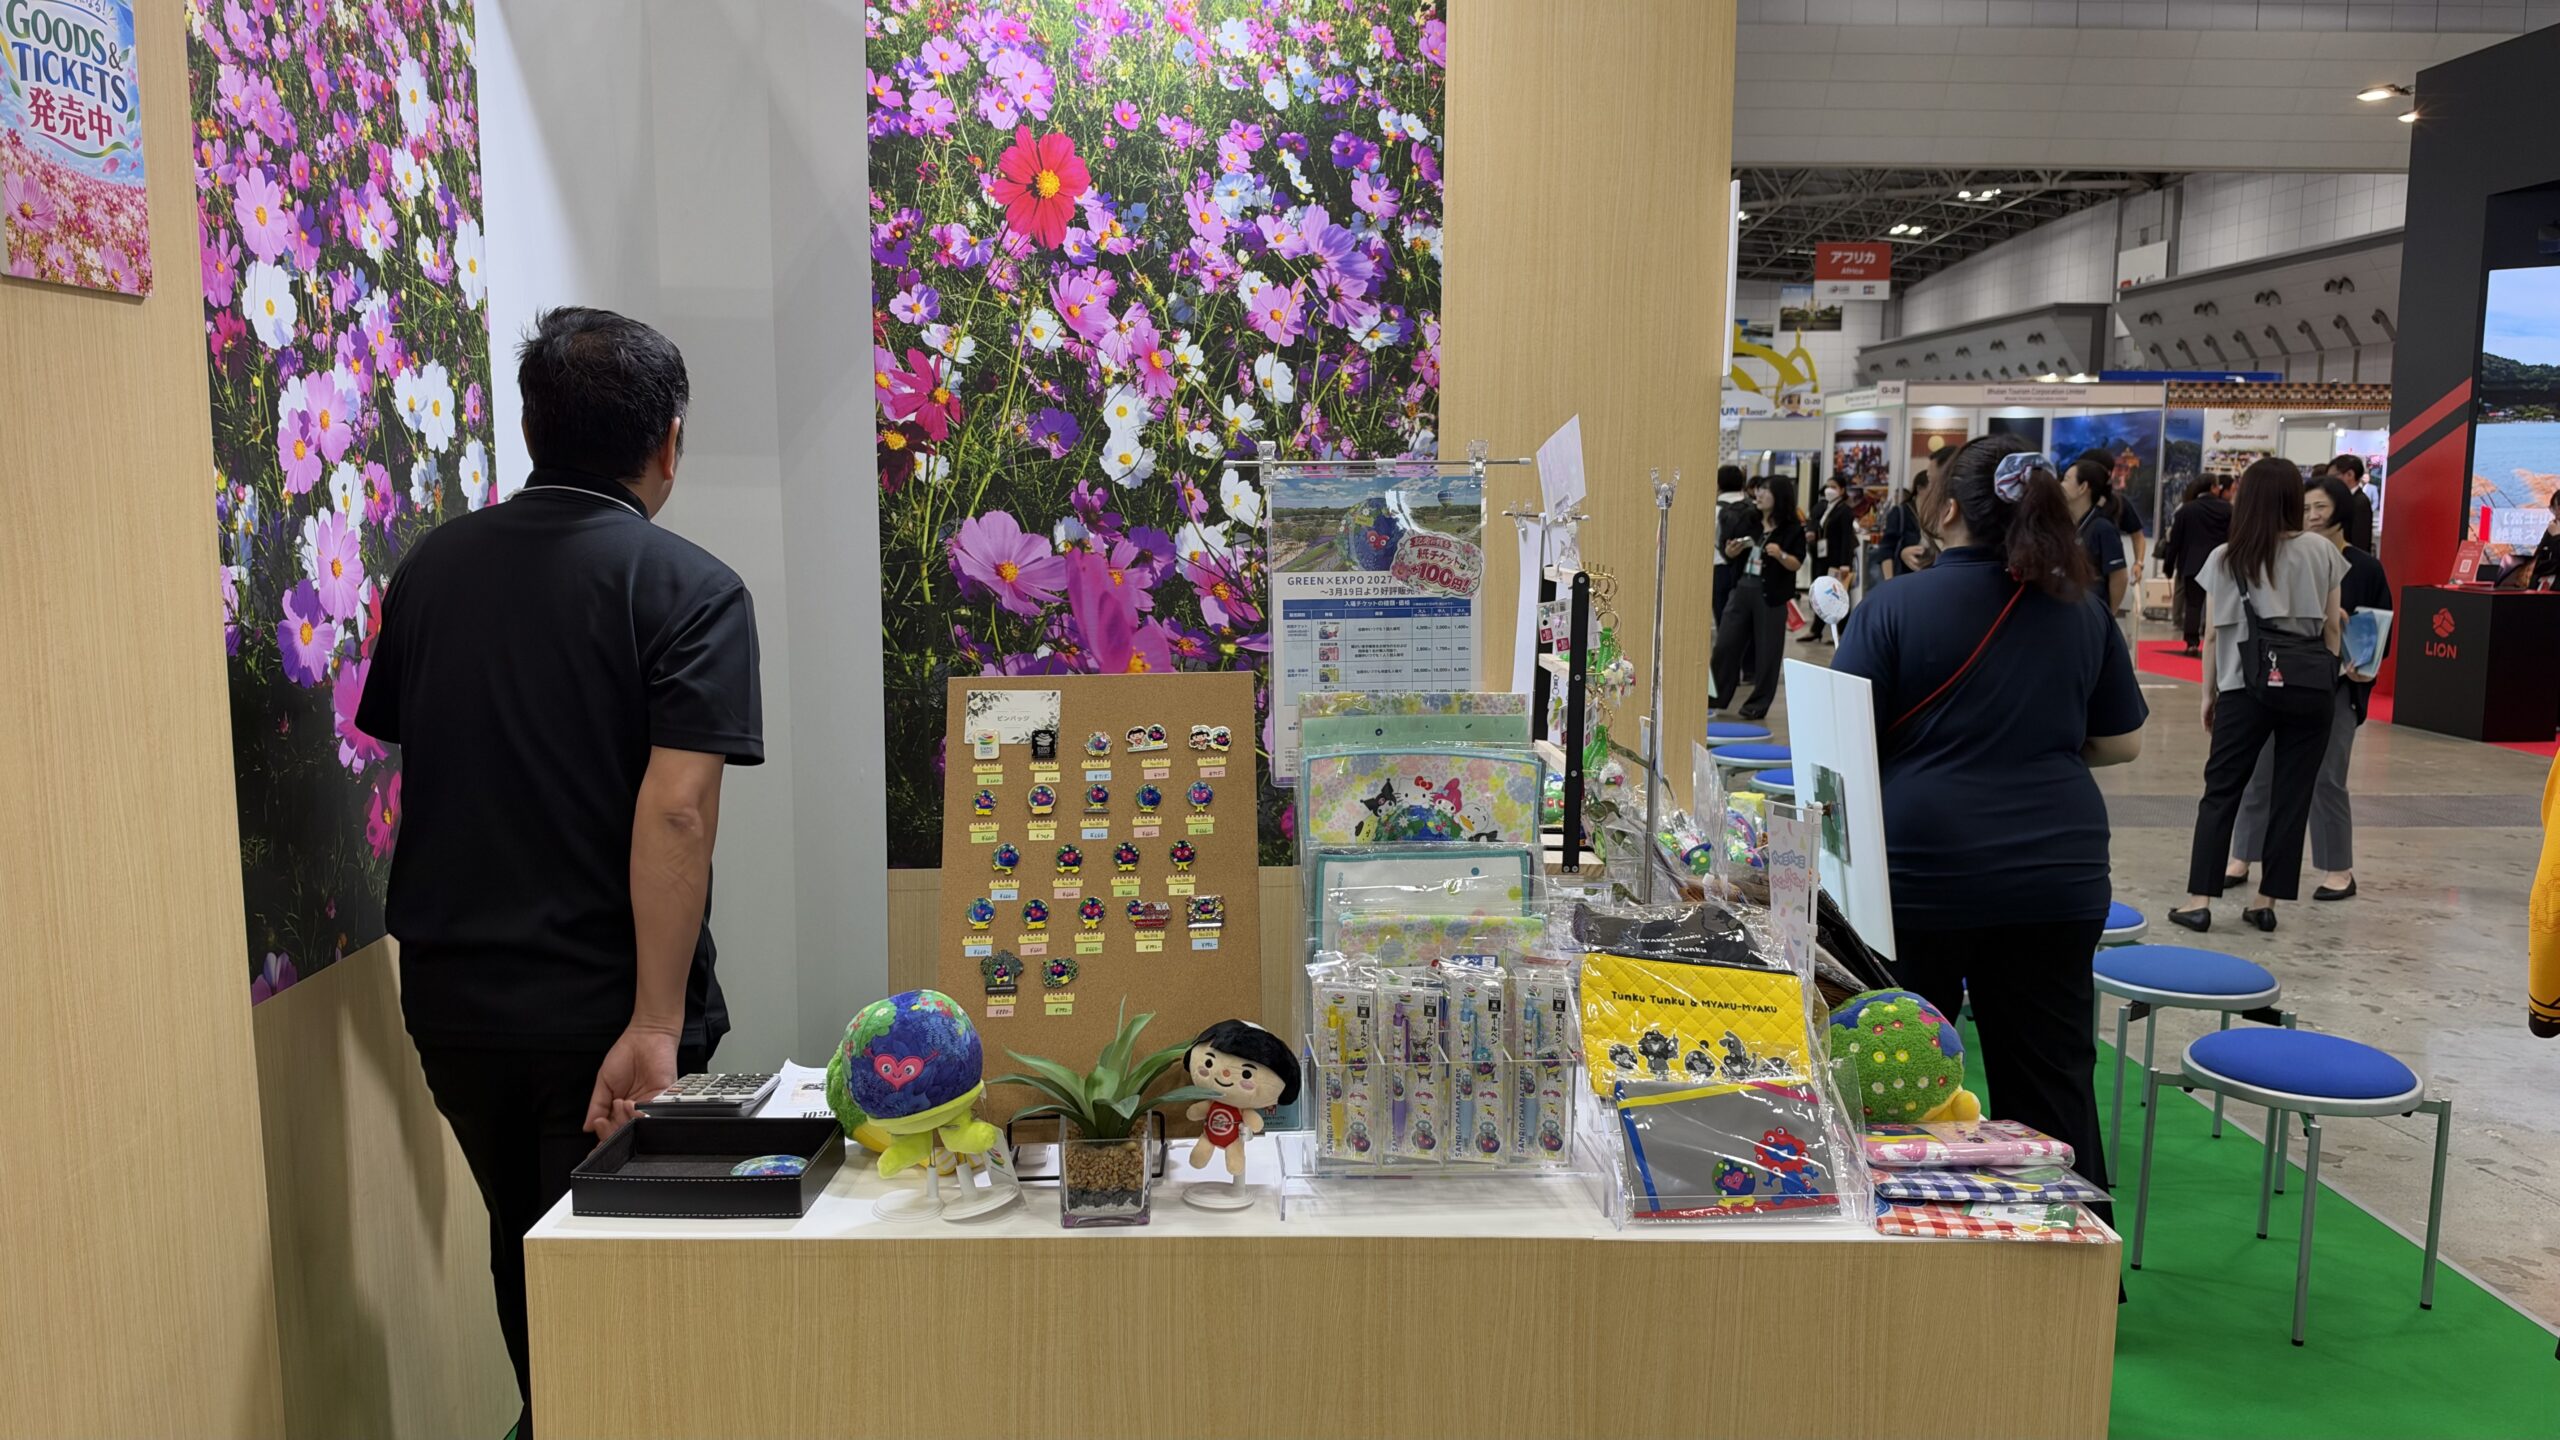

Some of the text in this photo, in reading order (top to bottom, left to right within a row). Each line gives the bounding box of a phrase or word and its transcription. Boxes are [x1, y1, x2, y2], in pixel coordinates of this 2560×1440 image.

[11, 41, 128, 114] TICKETS
[28, 86, 112, 147] 発売中
[1830, 251, 1877, 265] アフリカ
[1840, 266, 1865, 275] Africa
[1417, 547, 1466, 571] 紙チケットは
[1367, 575, 1393, 585] 2027
[2424, 640, 2457, 660] LION
[1676, 946, 1708, 954] Tunku
[1611, 991, 1778, 1013] Tunku Tunku & MYAKU-MYAKU
[1360, 1019, 1368, 1049] ボールペン
[1426, 1018, 1434, 1048] ボールペン
[1491, 1013, 1499, 1044] ボールペン
[1326, 1125, 1334, 1155] SANRIO
[1517, 1122, 1526, 1154] SANRIO
